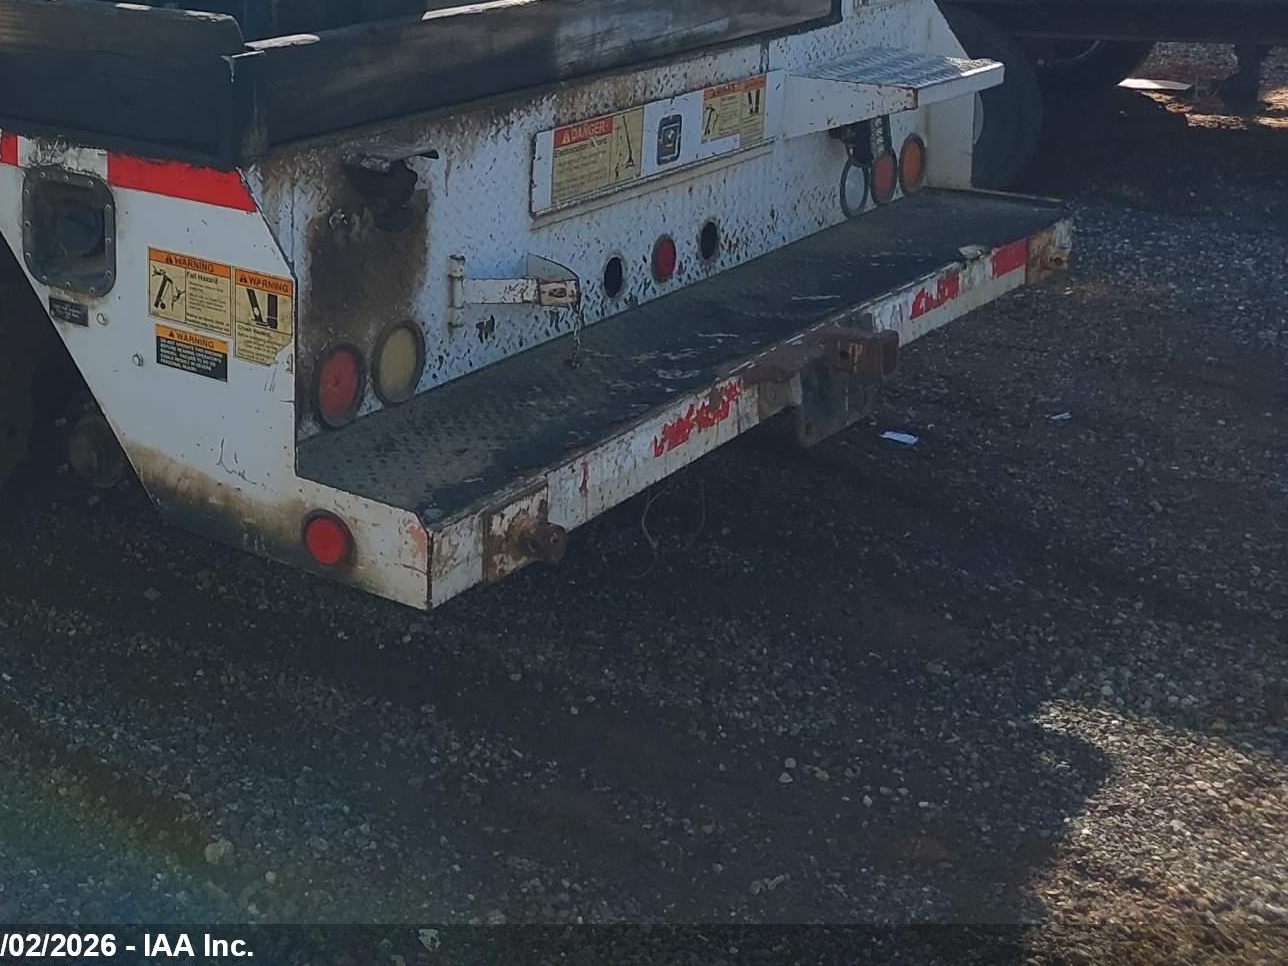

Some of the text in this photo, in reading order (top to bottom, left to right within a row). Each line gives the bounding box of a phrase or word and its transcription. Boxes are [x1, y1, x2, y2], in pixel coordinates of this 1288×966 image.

[571, 121, 606, 140] DANGER
[172, 255, 215, 274] WARNING
[249, 275, 289, 293] WARNING
[176, 332, 215, 349] WARNING
